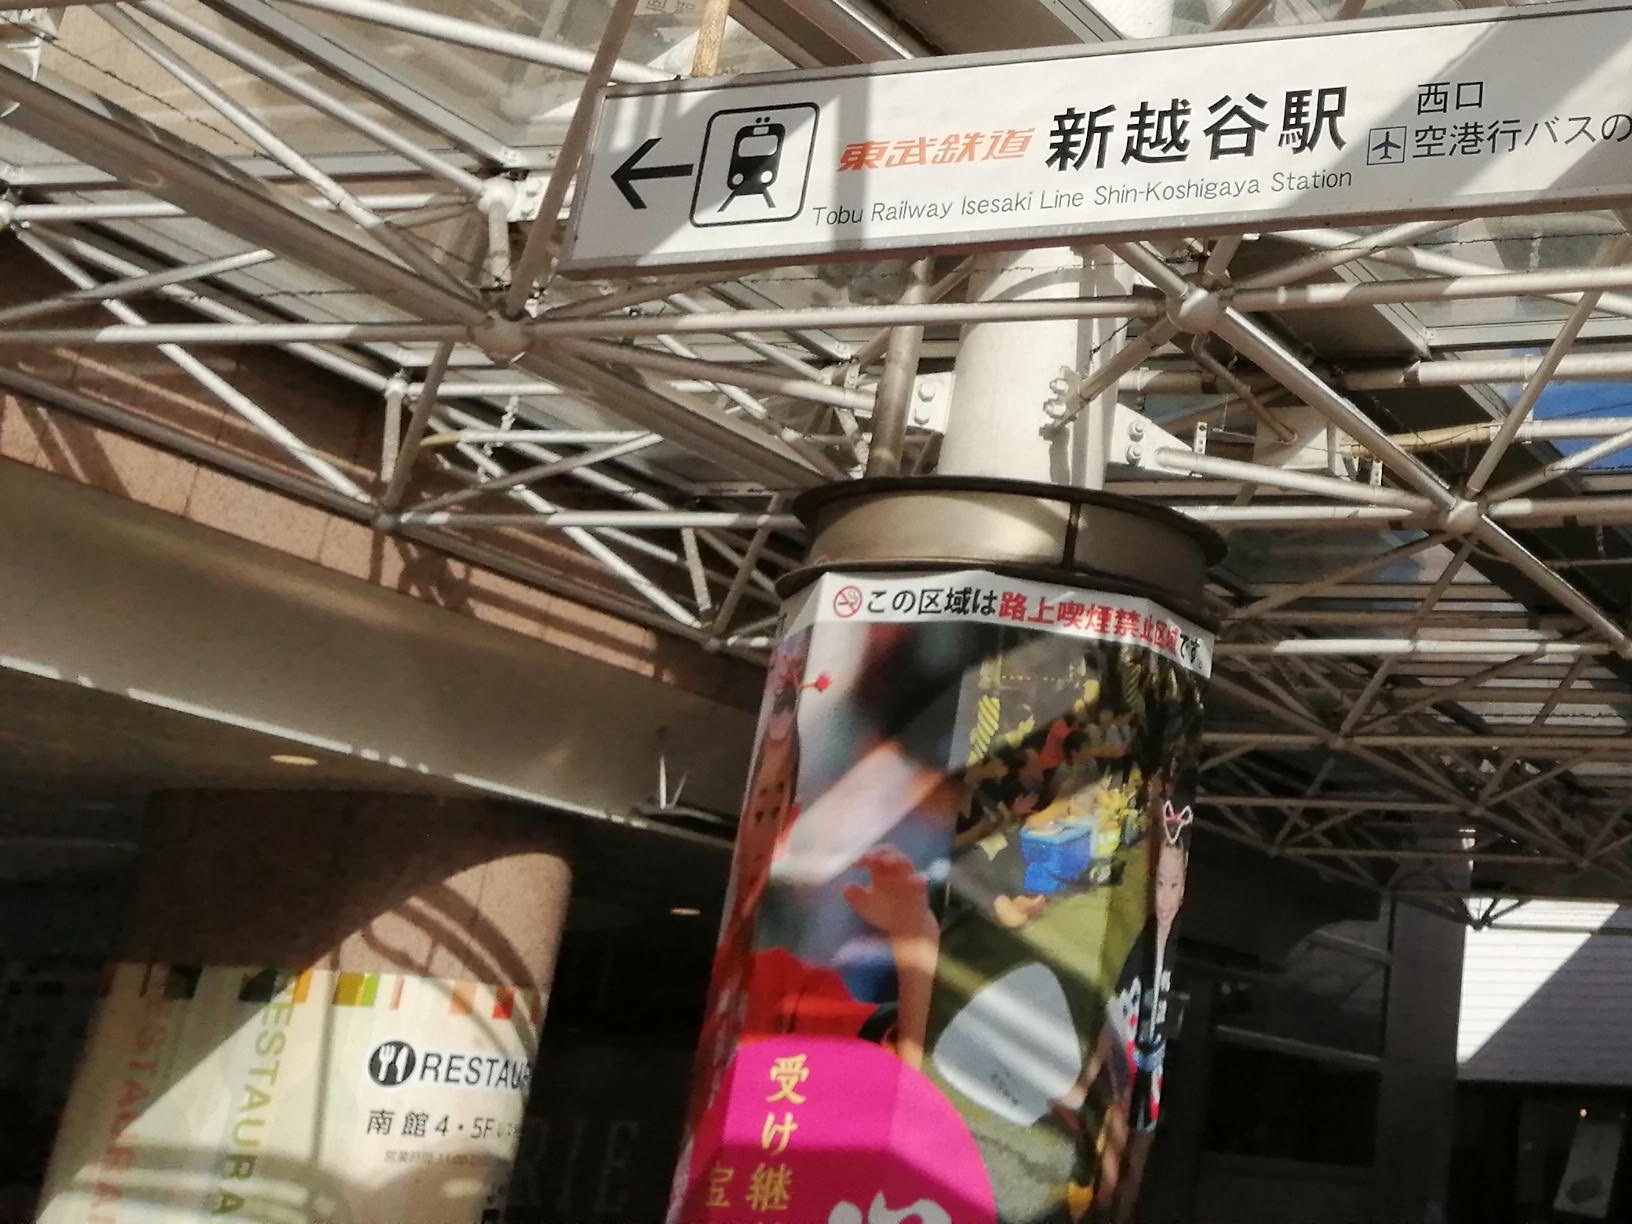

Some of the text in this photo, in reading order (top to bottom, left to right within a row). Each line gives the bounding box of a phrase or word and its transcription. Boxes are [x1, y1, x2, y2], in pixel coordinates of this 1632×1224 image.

[1417, 81, 1485, 116] 西口
[838, 86, 1349, 172] 東武鉄道 新越谷駅
[812, 168, 1353, 226] Tobu Railway Isesaki Line Shin-Koshigaya Station
